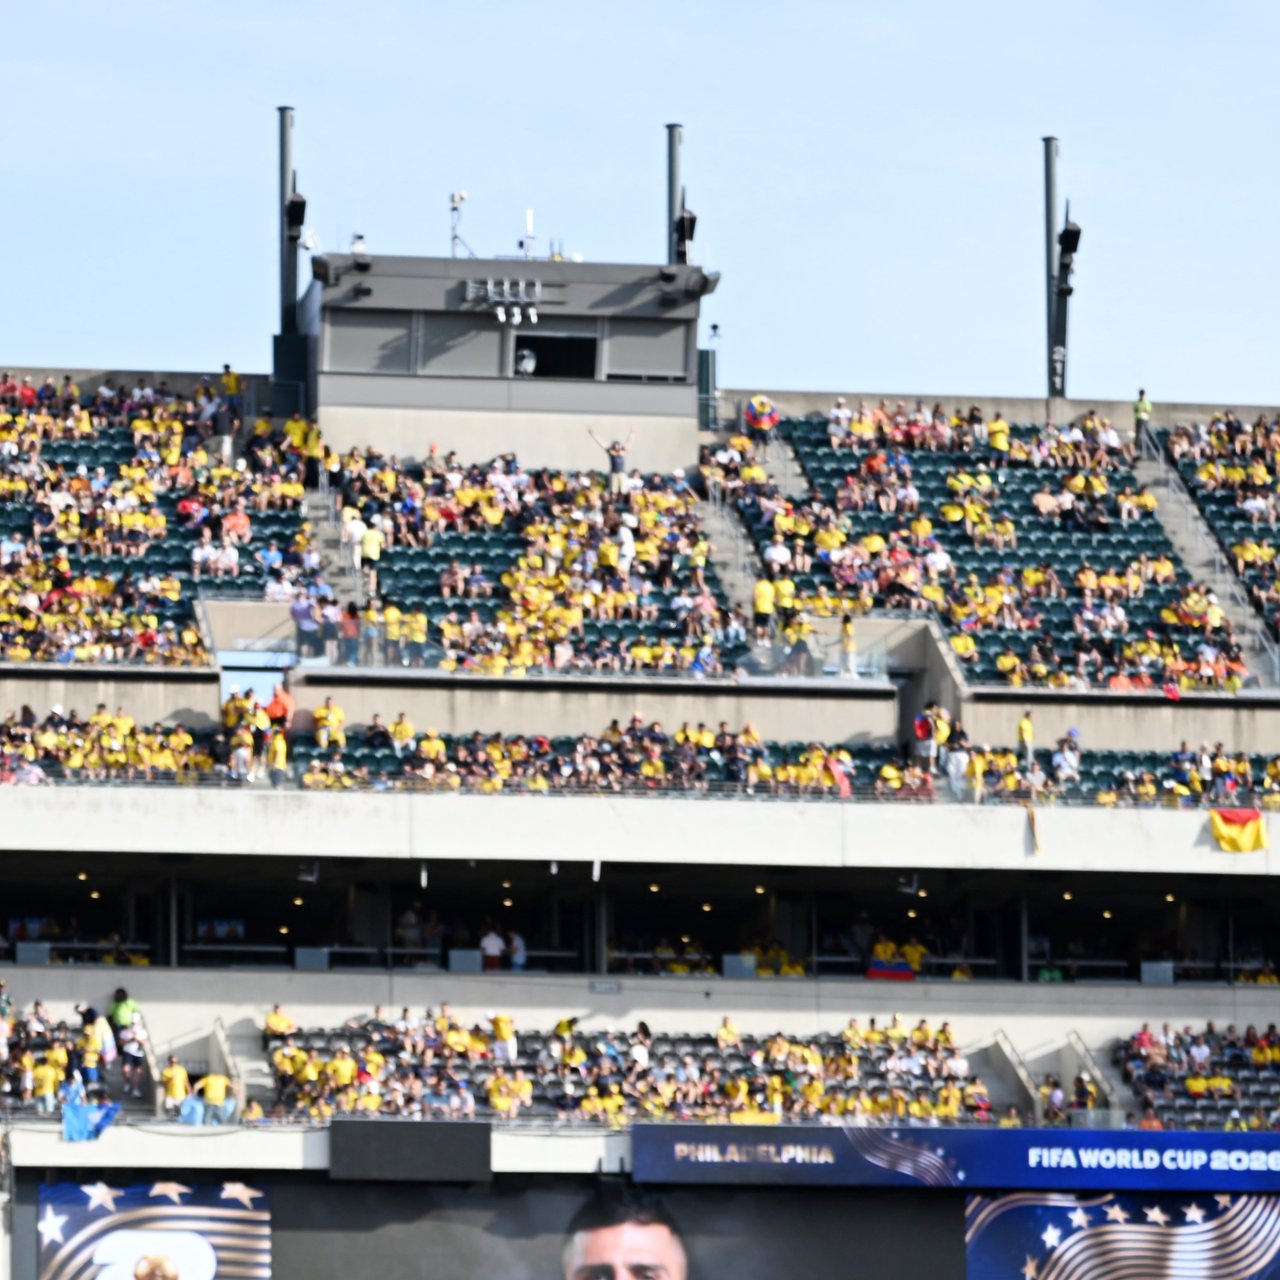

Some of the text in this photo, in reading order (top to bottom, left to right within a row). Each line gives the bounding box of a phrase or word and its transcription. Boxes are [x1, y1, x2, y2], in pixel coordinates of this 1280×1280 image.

[674, 1142, 835, 1164] PHILADELPHIA
[1028, 1147, 1077, 1168] FIFA
[1078, 1148, 1160, 1169] WORLD
[1162, 1149, 1207, 1169] CUP
